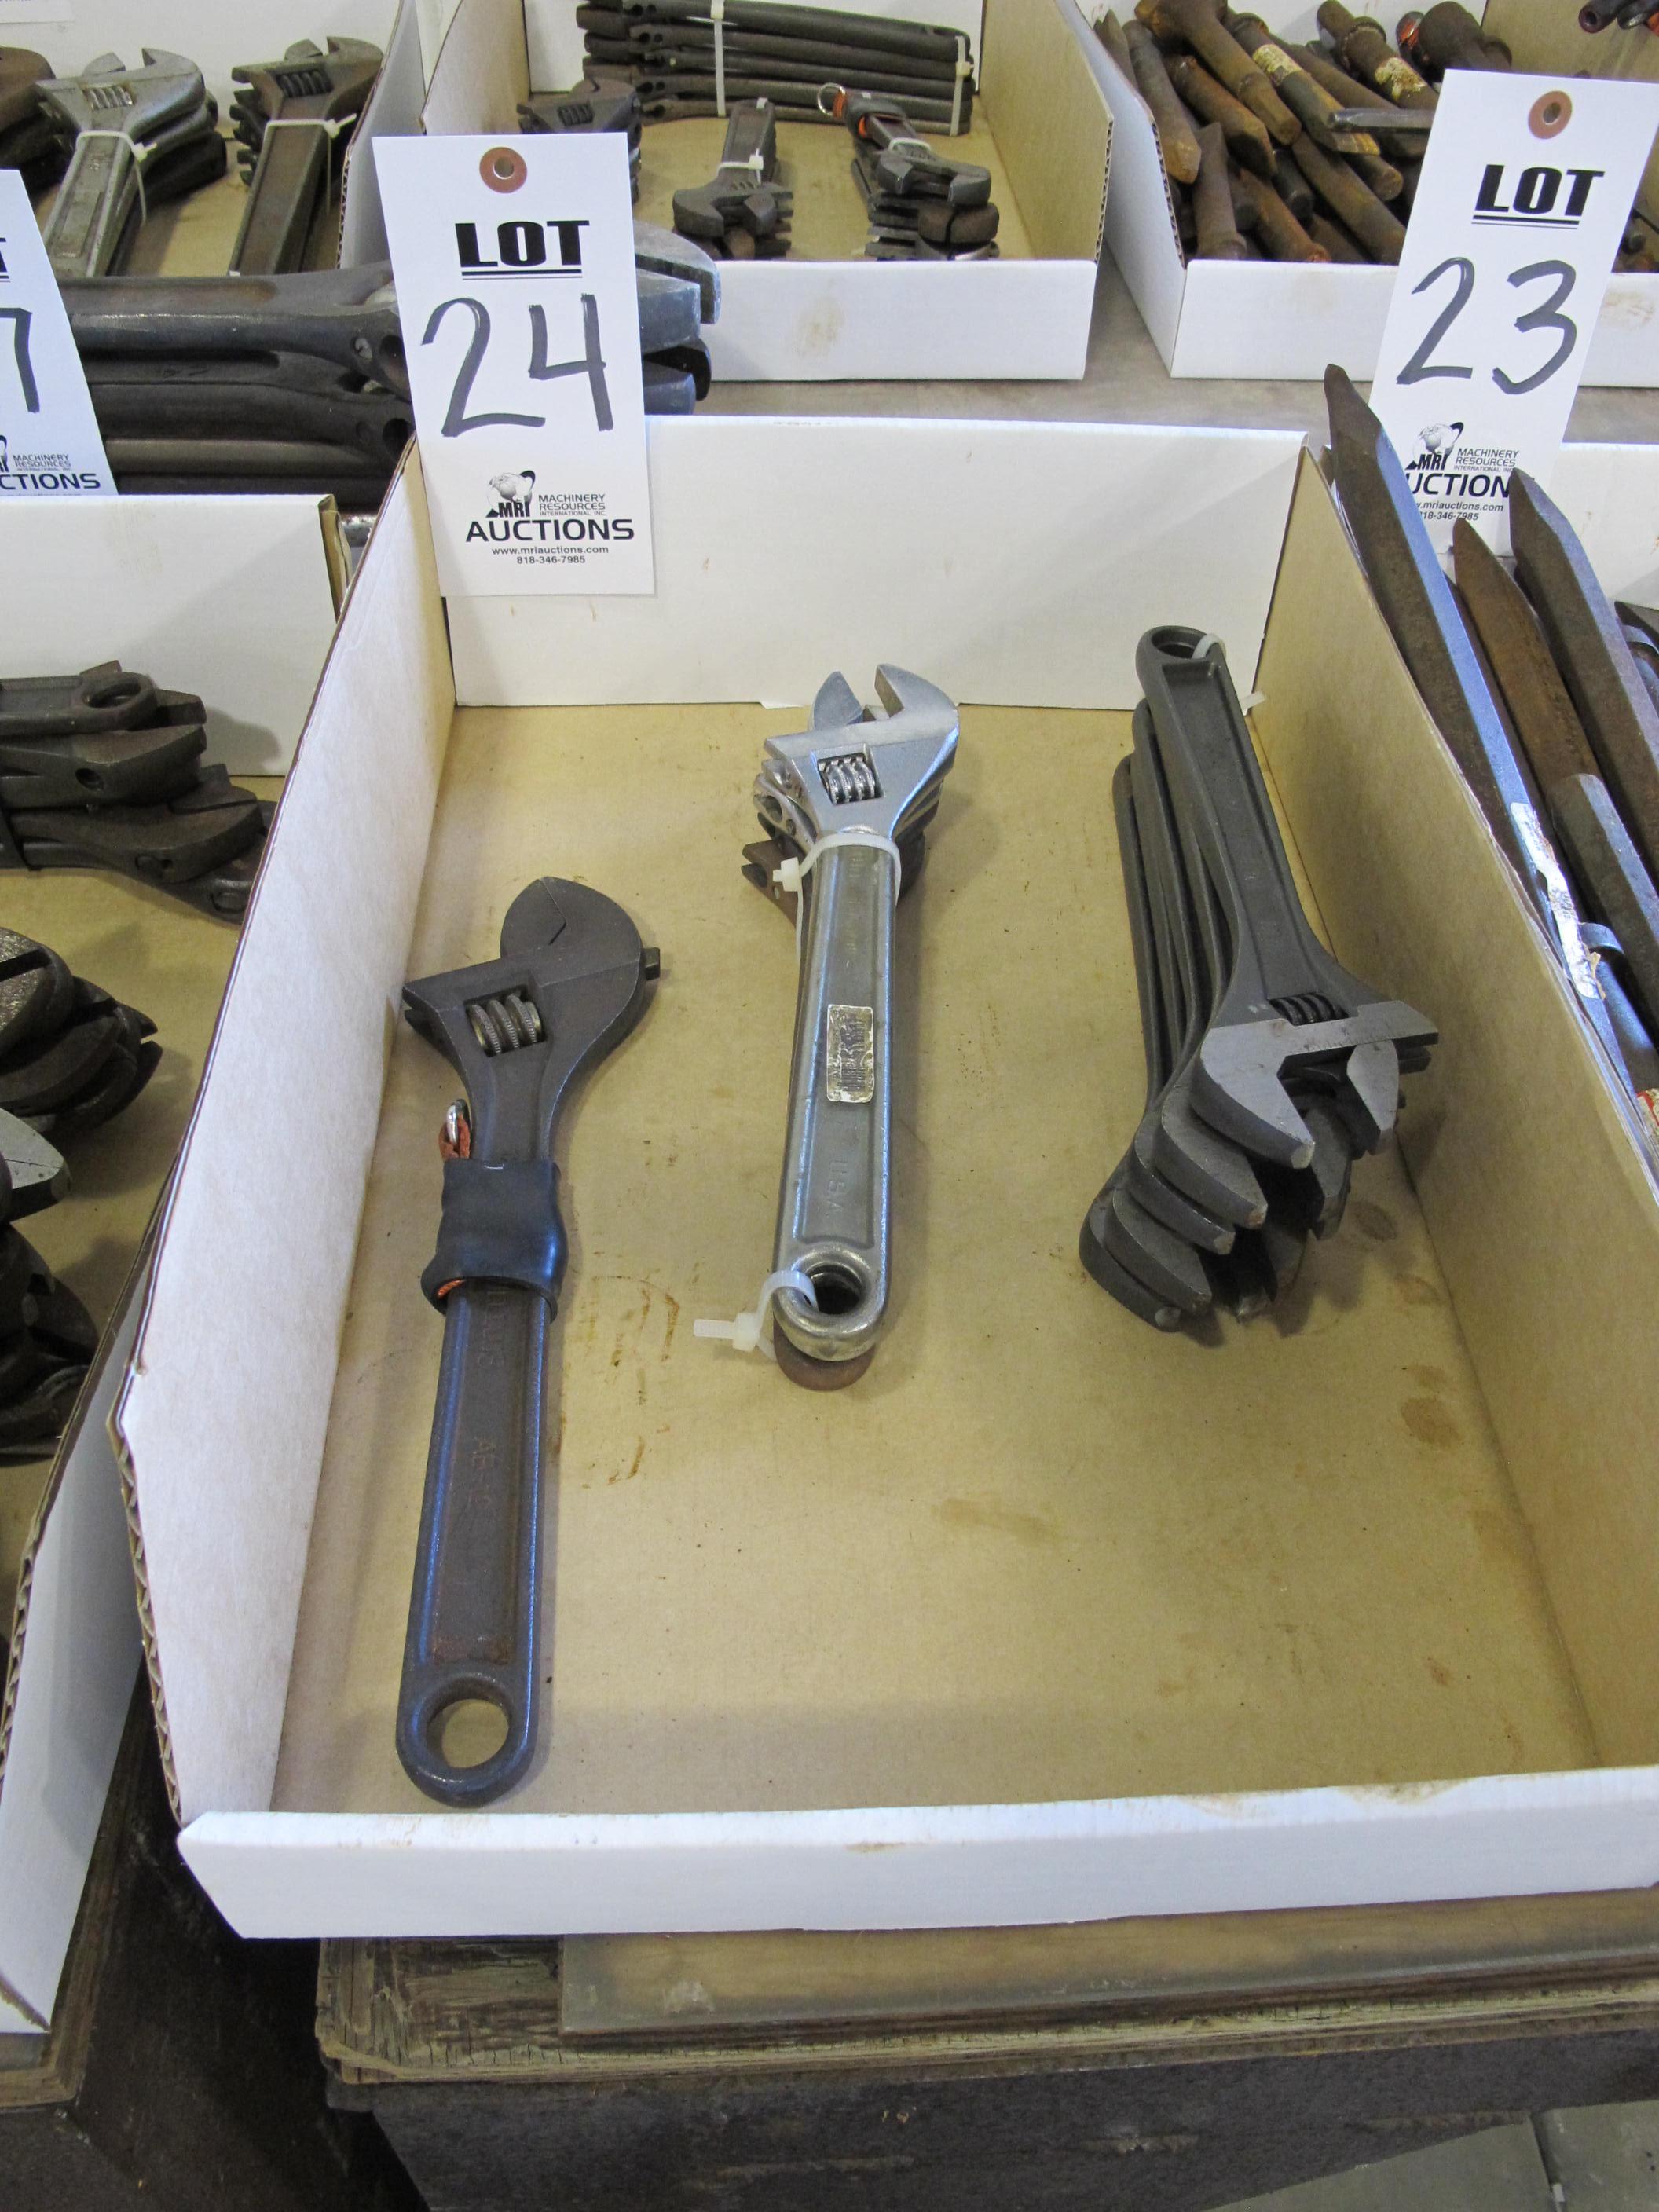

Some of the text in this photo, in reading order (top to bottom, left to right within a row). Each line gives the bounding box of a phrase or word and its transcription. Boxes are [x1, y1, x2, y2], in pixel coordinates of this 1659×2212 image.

[1475, 164, 1605, 216] LOT
[455, 220, 589, 267] LOT
[1397, 257, 1577, 394] 23
[420, 294, 613, 438] 24
[1456, 456, 1516, 467] RESOURCES
[1457, 448, 1519, 459] MACHINERY
[1417, 454, 1448, 470] MRI
[0, 473, 101, 490] CTIONS
[1405, 473, 1510, 498] UCTION
[538, 493, 605, 503] MACHINERY
[1416, 500, 1503, 511] .mriauctions.com
[498, 501, 531, 518] MRI
[540, 502, 606, 511] RESOURCES
[465, 518, 635, 542] AUCTIONS
[492, 546, 609, 555] www.mriauctions.com
[517, 555, 586, 564] 818-346-7985
